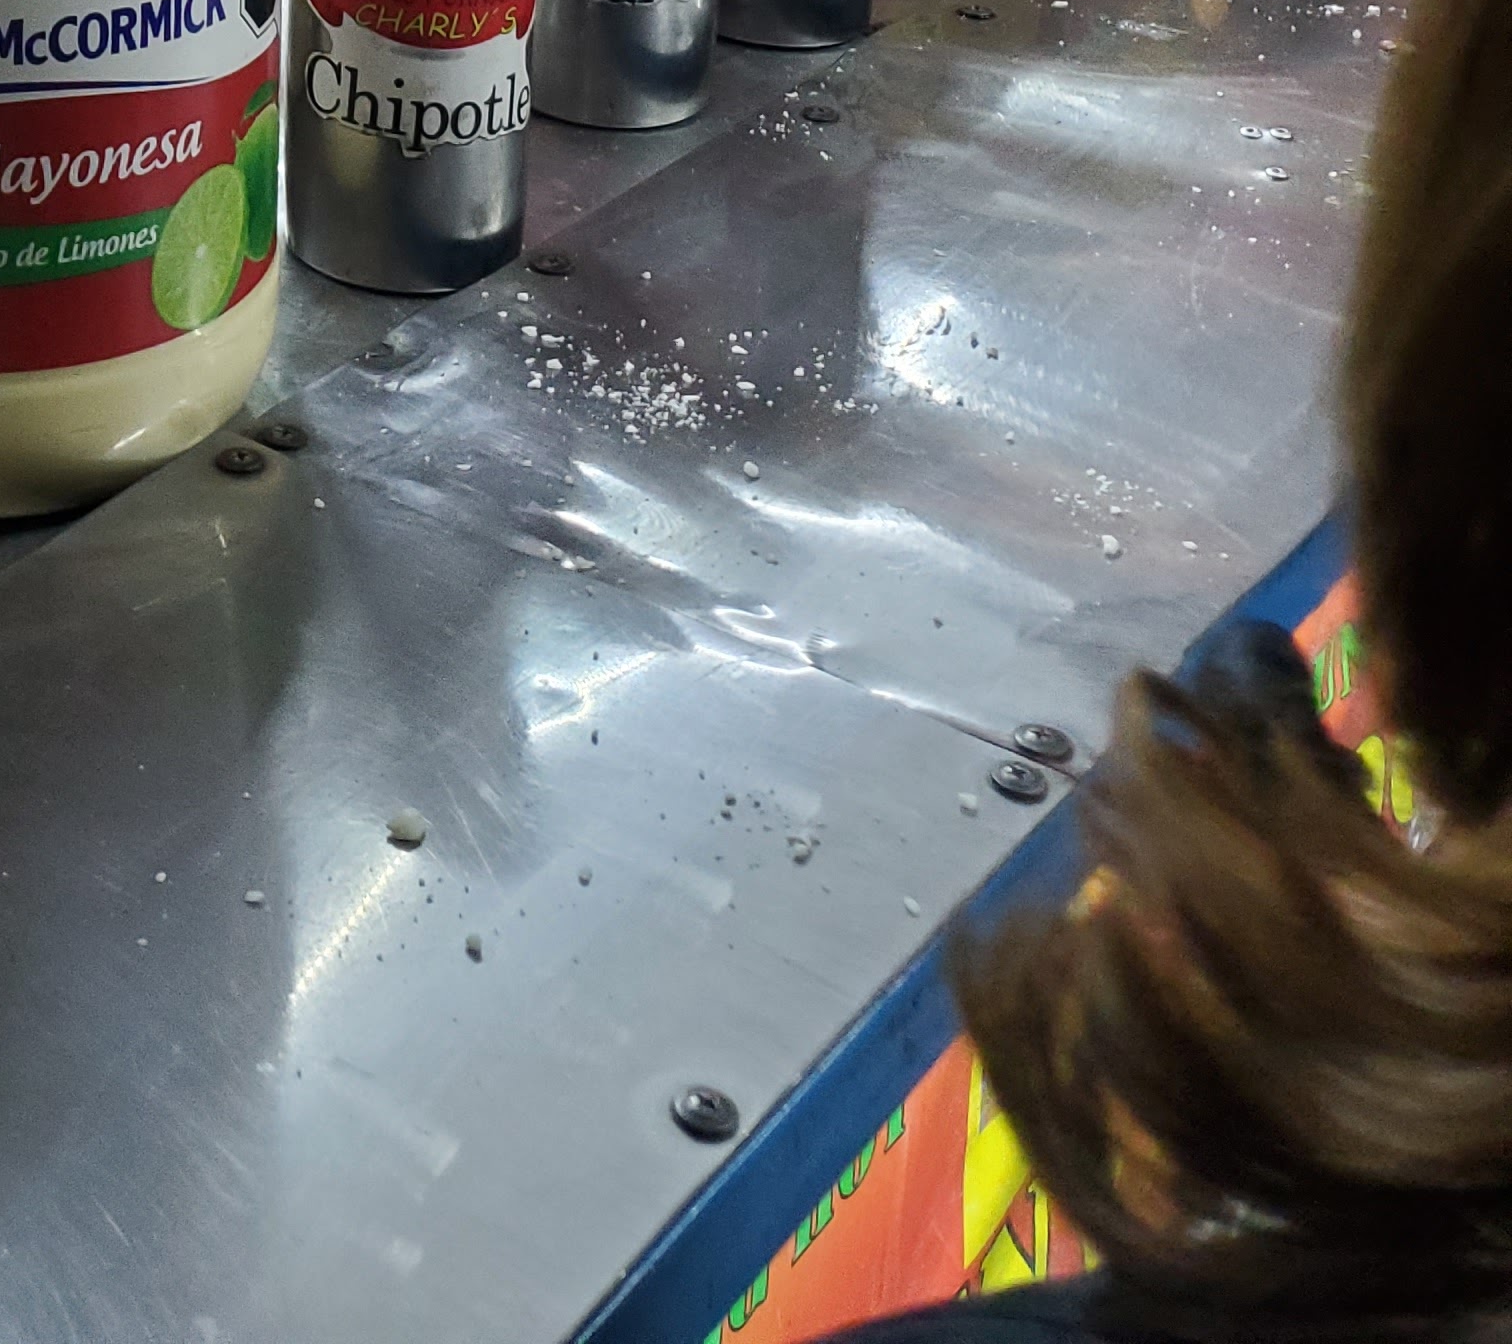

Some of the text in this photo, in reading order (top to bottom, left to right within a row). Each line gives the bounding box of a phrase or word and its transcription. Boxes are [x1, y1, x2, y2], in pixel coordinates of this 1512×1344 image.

[304, 52, 531, 154] Chipotle
[16, 241, 49, 267] de
[57, 223, 160, 264] Limones
